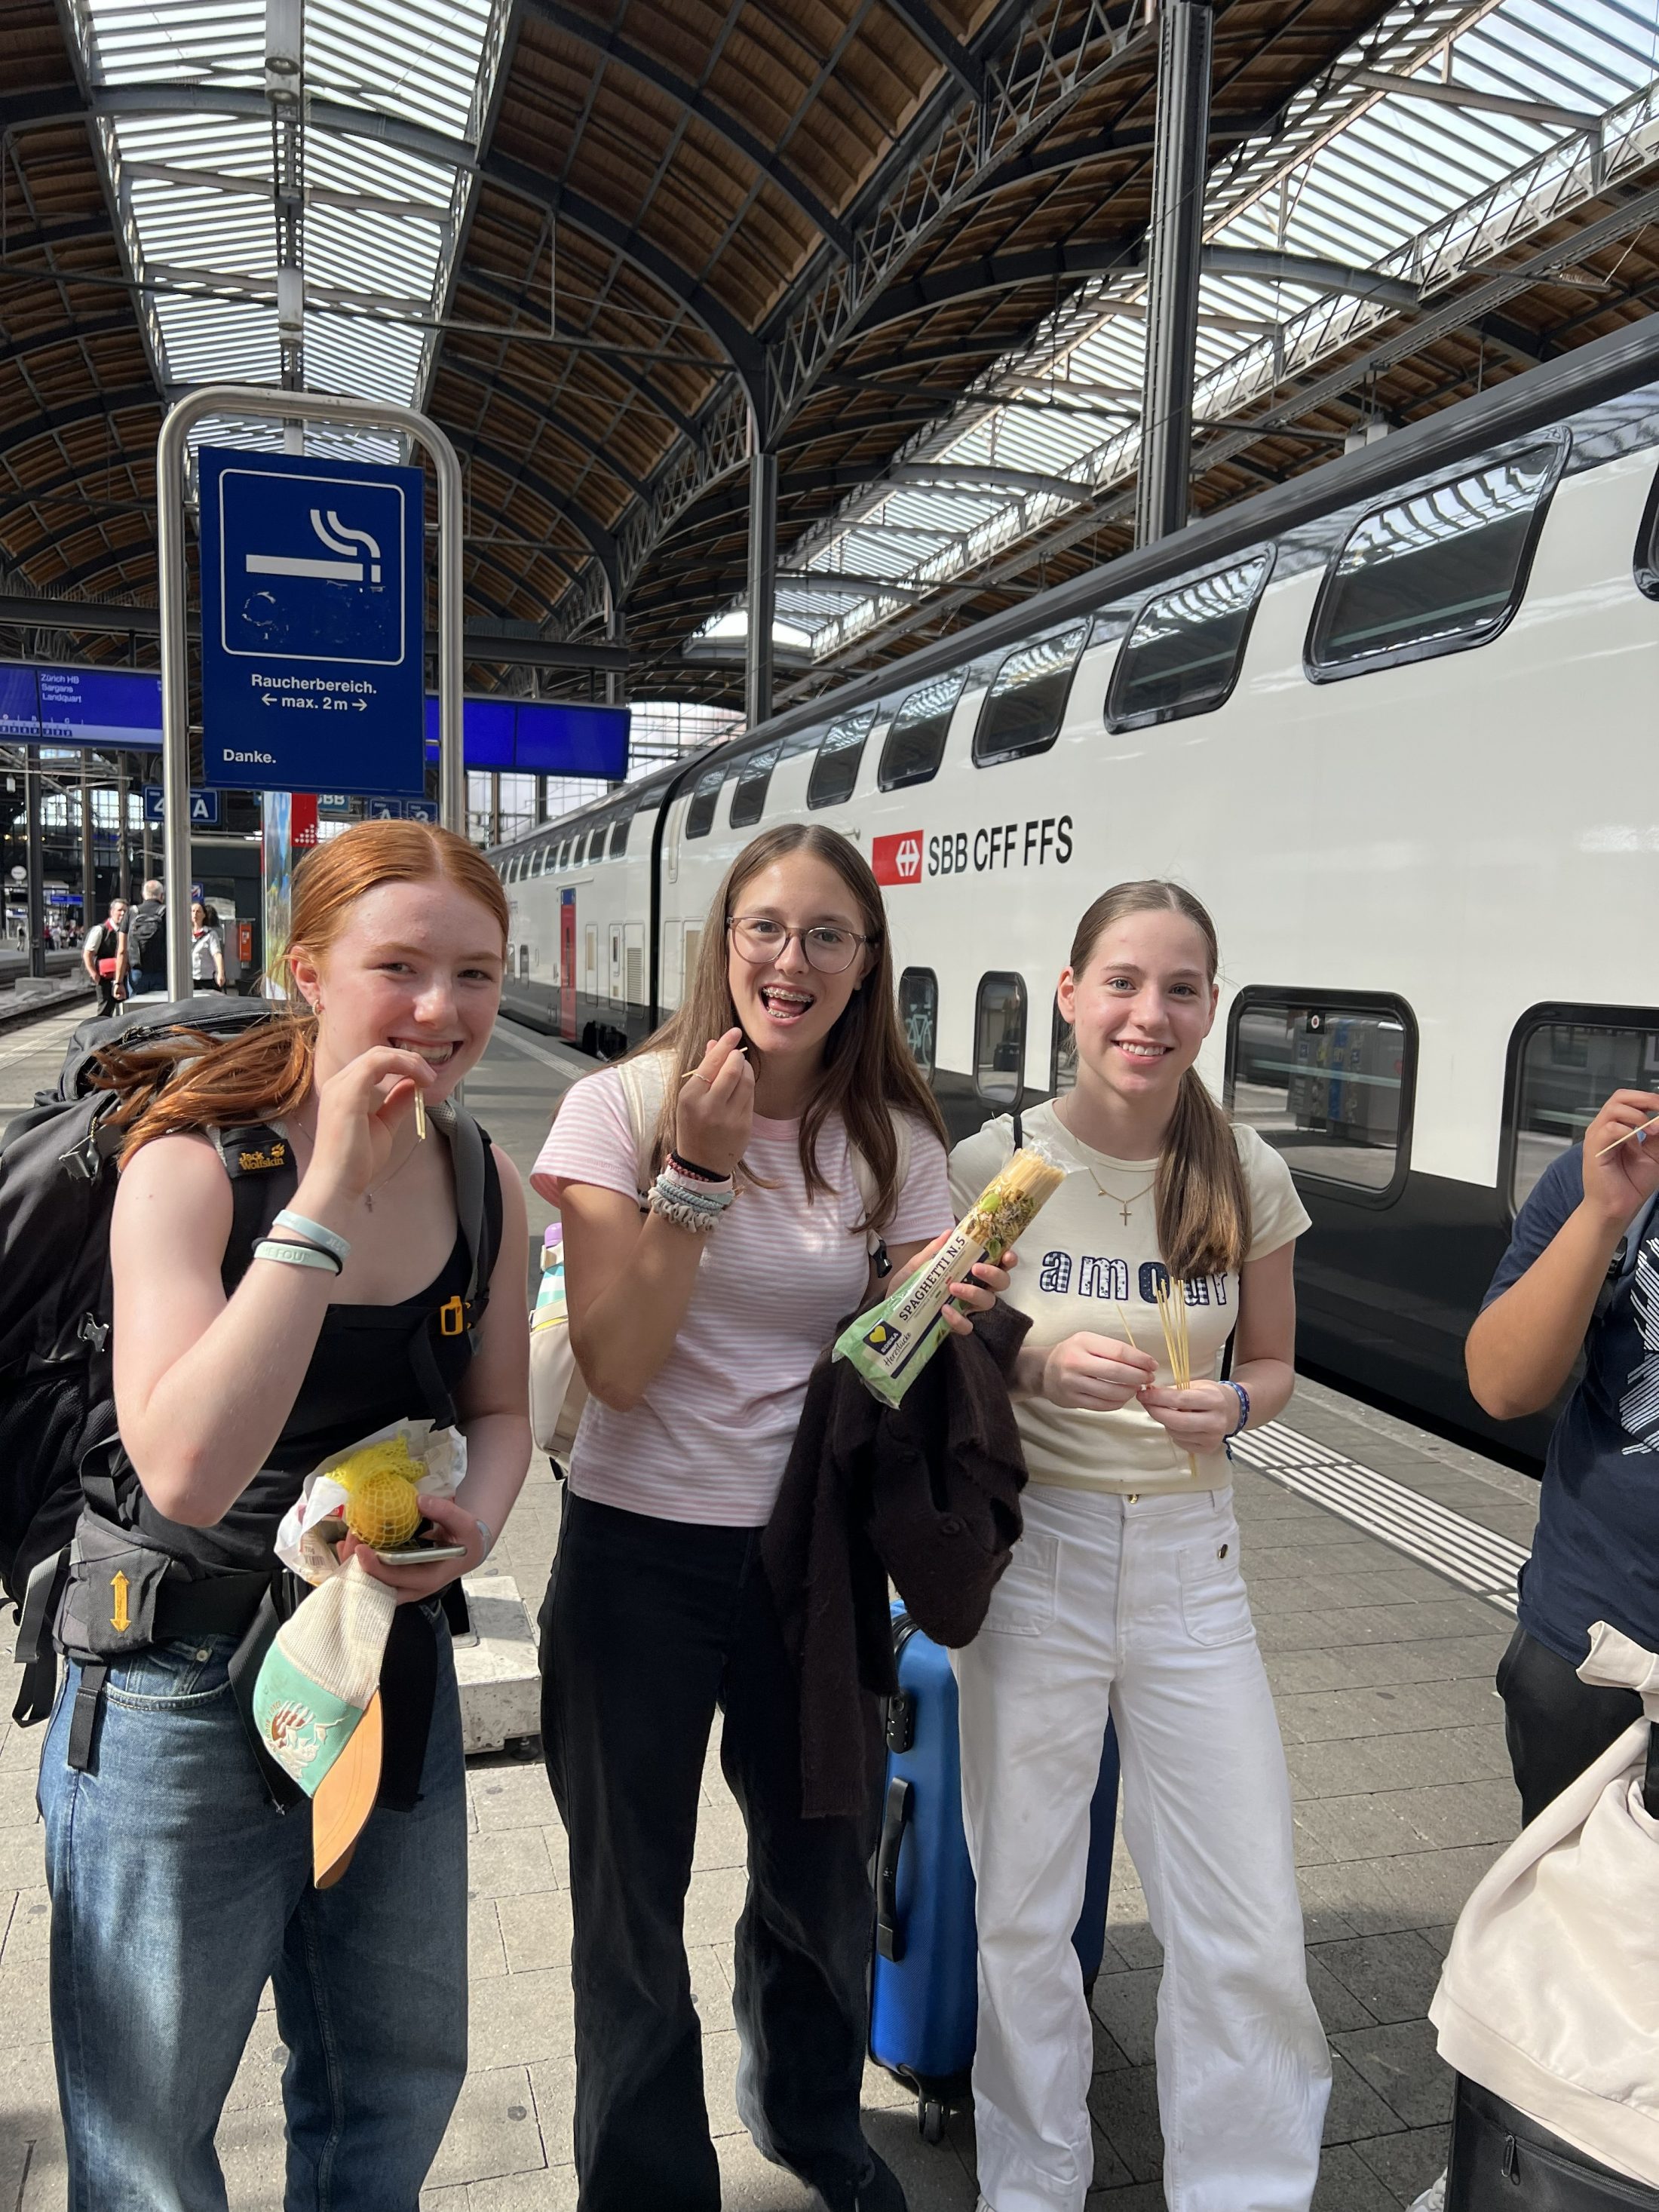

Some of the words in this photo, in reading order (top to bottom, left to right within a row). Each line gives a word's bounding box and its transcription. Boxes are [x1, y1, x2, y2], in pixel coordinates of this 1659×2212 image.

[41, 673, 66, 683] Zürich
[66, 676, 79, 684] HB
[251, 673, 377, 694] Raucherbereich.
[42, 692, 81, 703] Landquart
[281, 695, 318, 709] max.
[223, 749, 277, 763] Danke.
[192, 799, 209, 818] A
[928, 833, 967, 876] SBB
[974, 824, 1017, 871] CFF
[1024, 815, 1073, 866] FFS
[238, 1158, 284, 1170] Wolfskin
[239, 1151, 264, 1161] Jack
[899, 1256, 950, 1321] SPAGHETTI
[946, 1235, 965, 1258] N.5
[880, 1332, 899, 1353] EDEKA
[883, 1332, 911, 1367] Herzstücke
